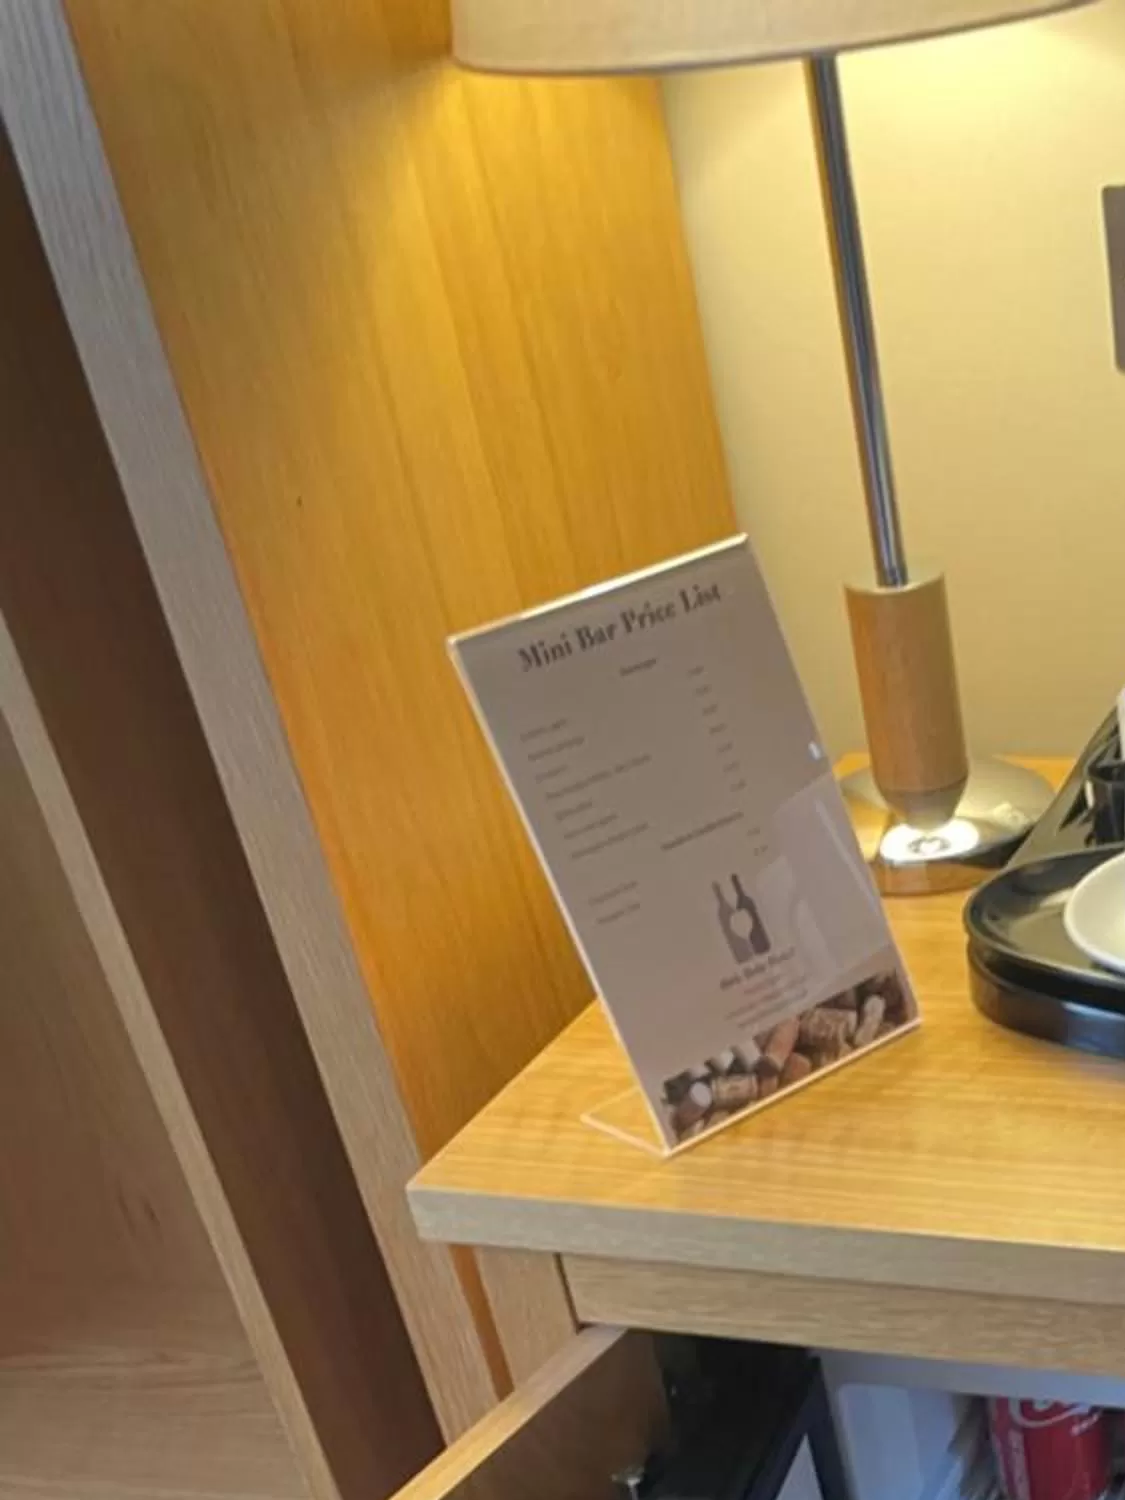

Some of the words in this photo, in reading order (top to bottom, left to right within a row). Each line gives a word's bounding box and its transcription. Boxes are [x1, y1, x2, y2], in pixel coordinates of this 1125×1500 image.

[517, 631, 573, 673] Mini
[574, 622, 618, 652] Bar
[619, 600, 677, 634] Price
[678, 583, 721, 613] List
